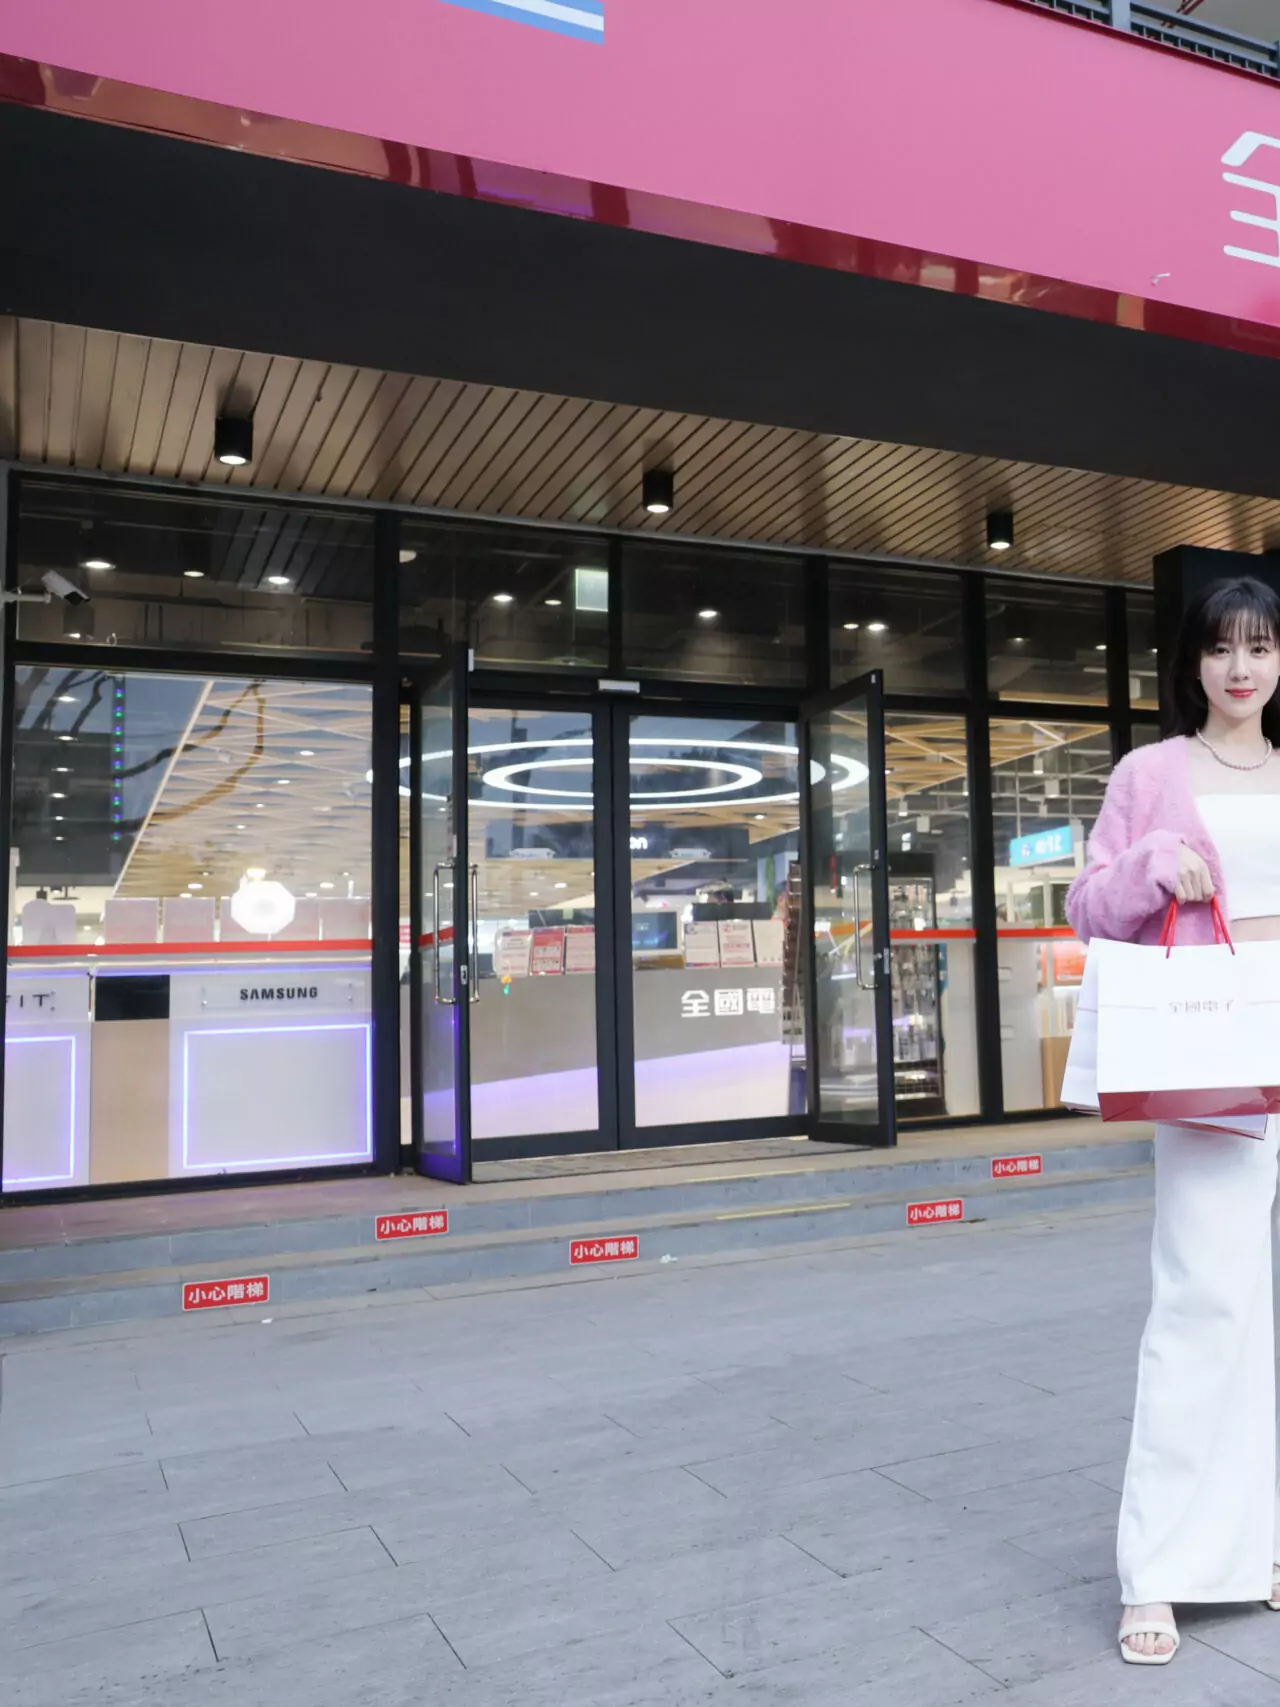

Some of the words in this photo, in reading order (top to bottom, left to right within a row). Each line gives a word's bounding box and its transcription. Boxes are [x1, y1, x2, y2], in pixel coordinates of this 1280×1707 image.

[240, 986, 318, 1001] SAMSUNG
[380, 1215, 444, 1235] 小心階梯
[188, 1282, 264, 1304] 小心階梯
